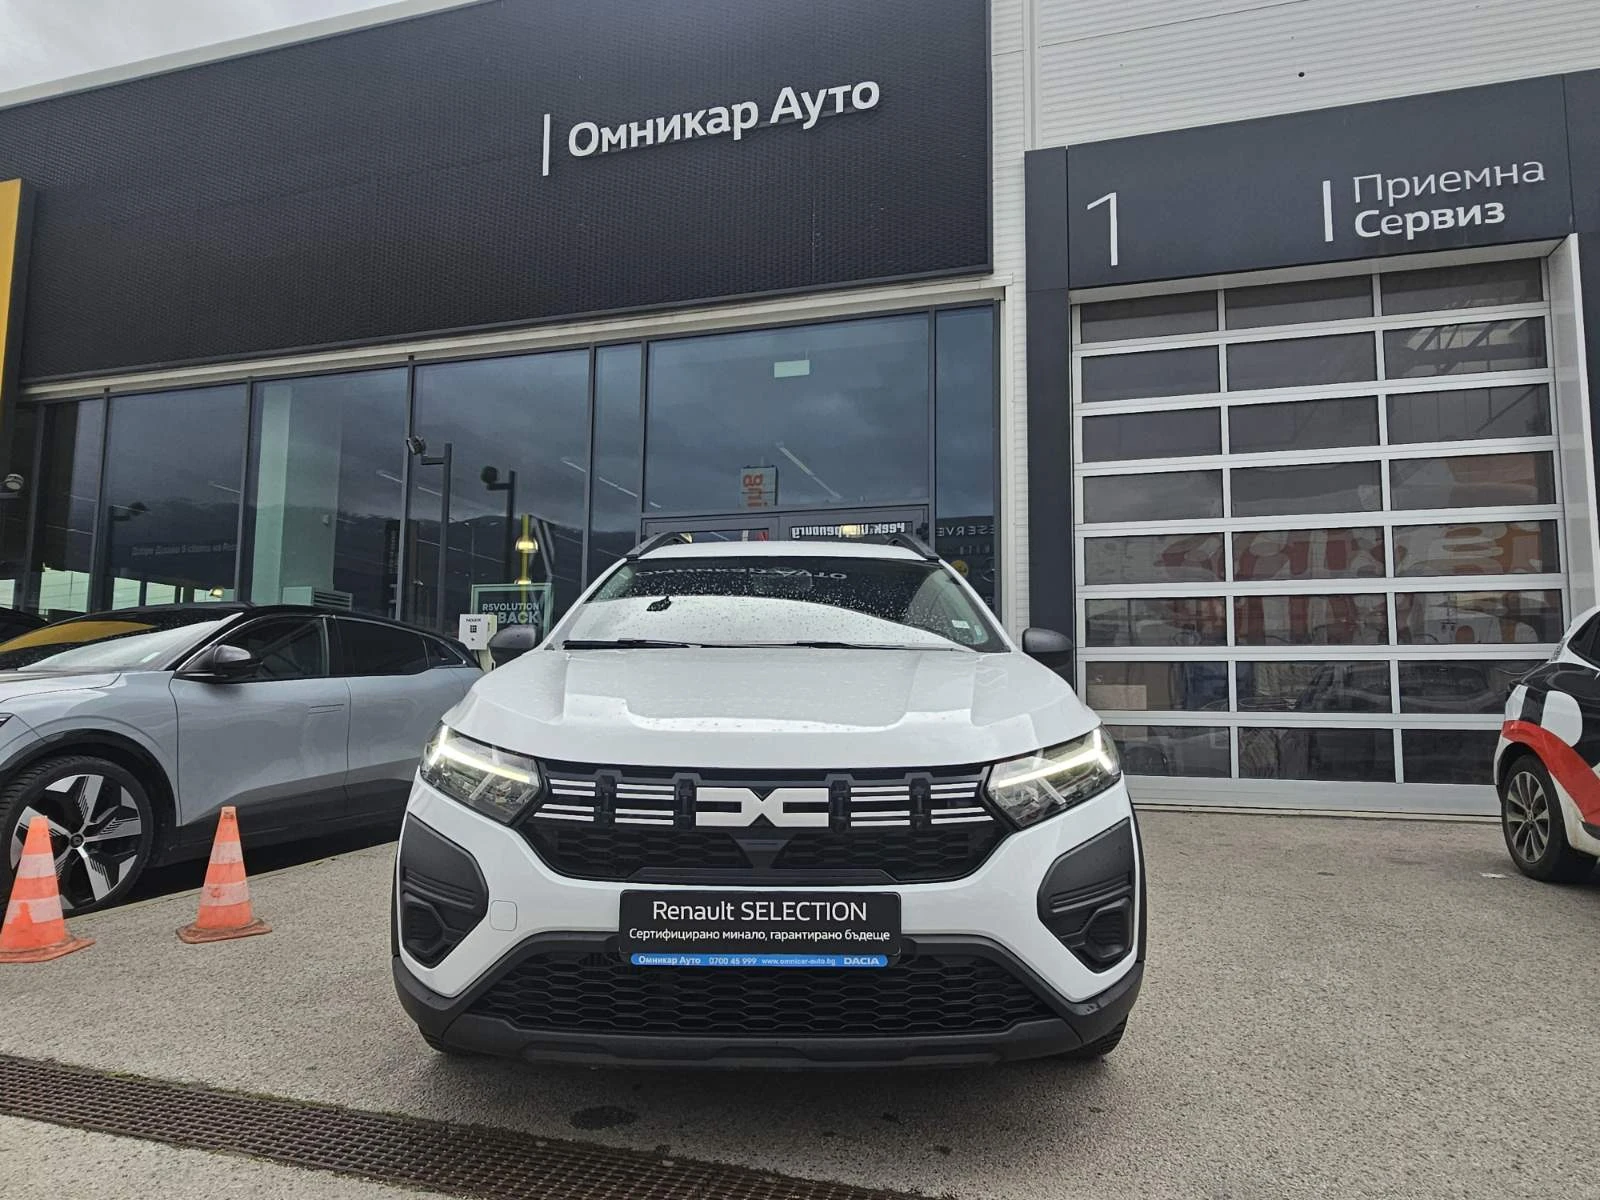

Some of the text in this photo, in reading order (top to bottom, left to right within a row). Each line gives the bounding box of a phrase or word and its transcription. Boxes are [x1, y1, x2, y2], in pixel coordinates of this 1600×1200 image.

[568, 79, 880, 158] Омникар Ауто
[1353, 160, 1546, 208] Приемна
[1086, 191, 1119, 267] 1
[1354, 201, 1507, 241] Сервиз
[498, 611, 540, 625] BACK
[652, 901, 867, 922] Renault SELECTION
[629, 927, 891, 943] Сертифицирано минало, гарантирано бъдеще
[638, 955, 678, 966] Омникар
[679, 956, 701, 967] Ауто
[708, 957, 729, 966] 0700
[730, 957, 741, 966] 45
[742, 957, 758, 966] 999
[843, 957, 880, 966] DACIA
